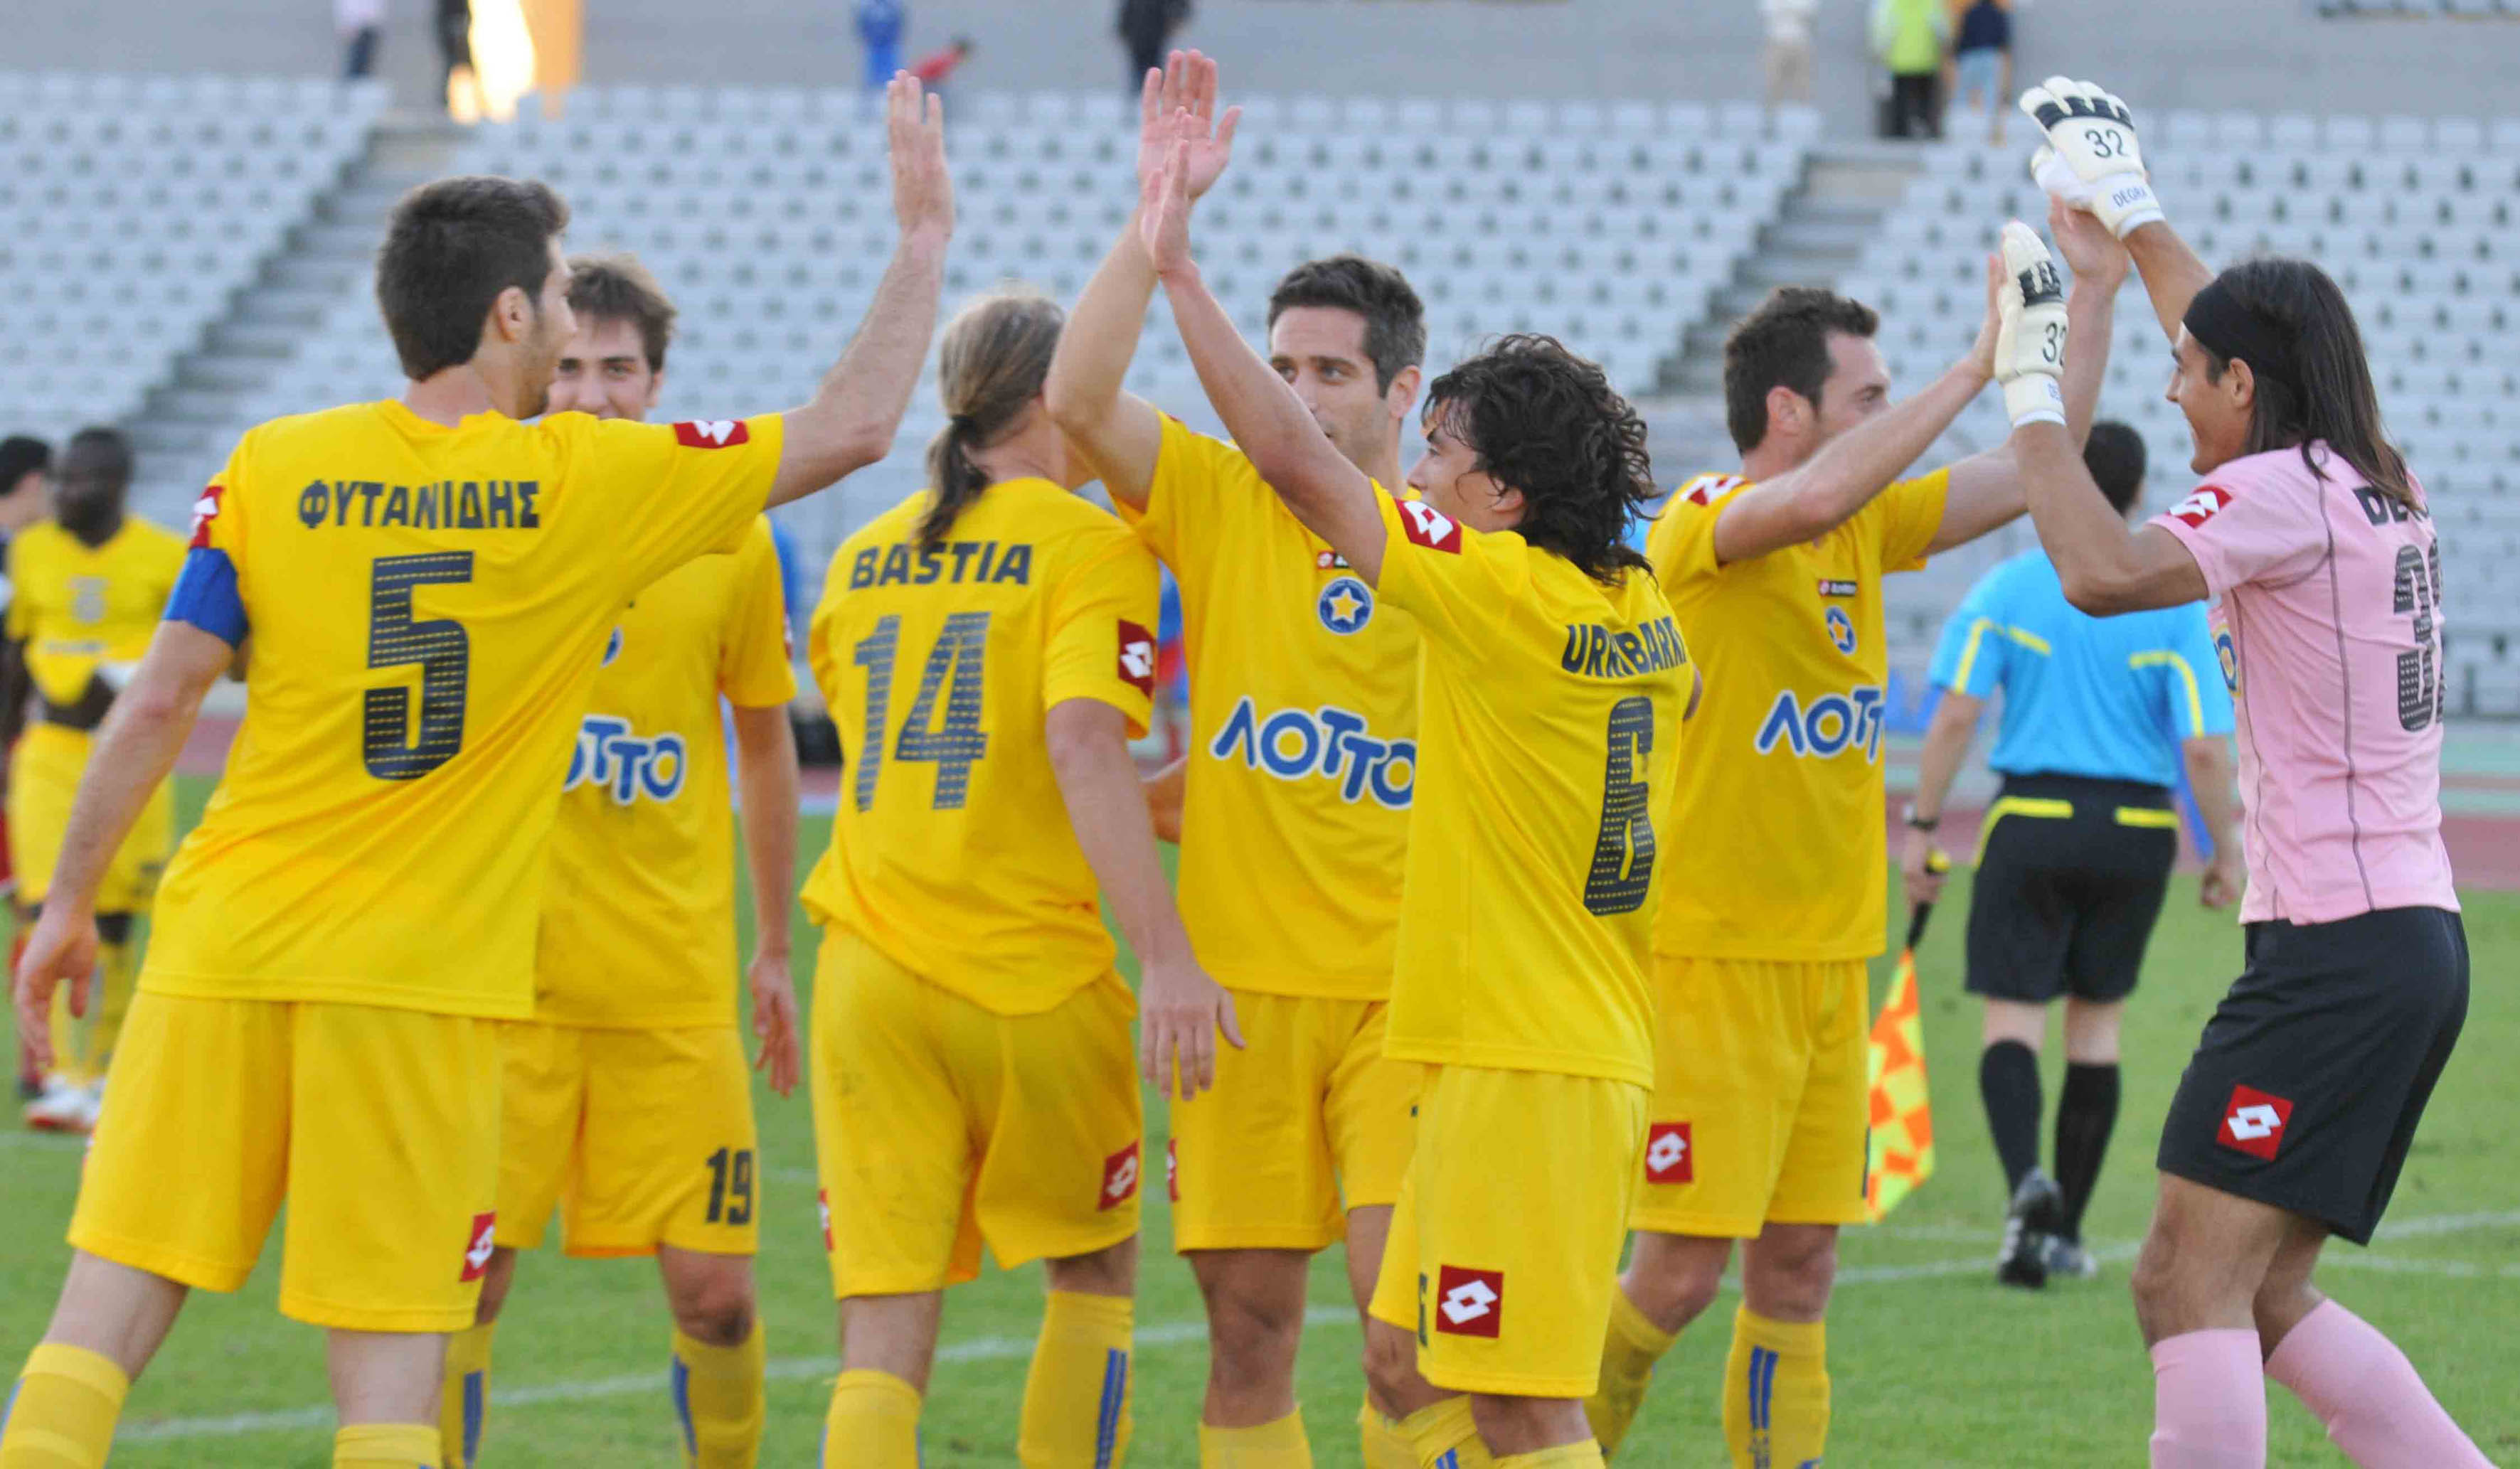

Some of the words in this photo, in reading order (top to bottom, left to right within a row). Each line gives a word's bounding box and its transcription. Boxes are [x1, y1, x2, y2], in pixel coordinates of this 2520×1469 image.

[2085, 129, 2129, 159] 32
[298, 480, 540, 529] ΦΥΤΑΝΙΔΗΣ
[849, 541, 1033, 591] BASTIA
[363, 550, 474, 781] 5
[854, 611, 991, 815] 14
[1583, 696, 1656, 917] 6
[706, 1146, 752, 1225] 19
